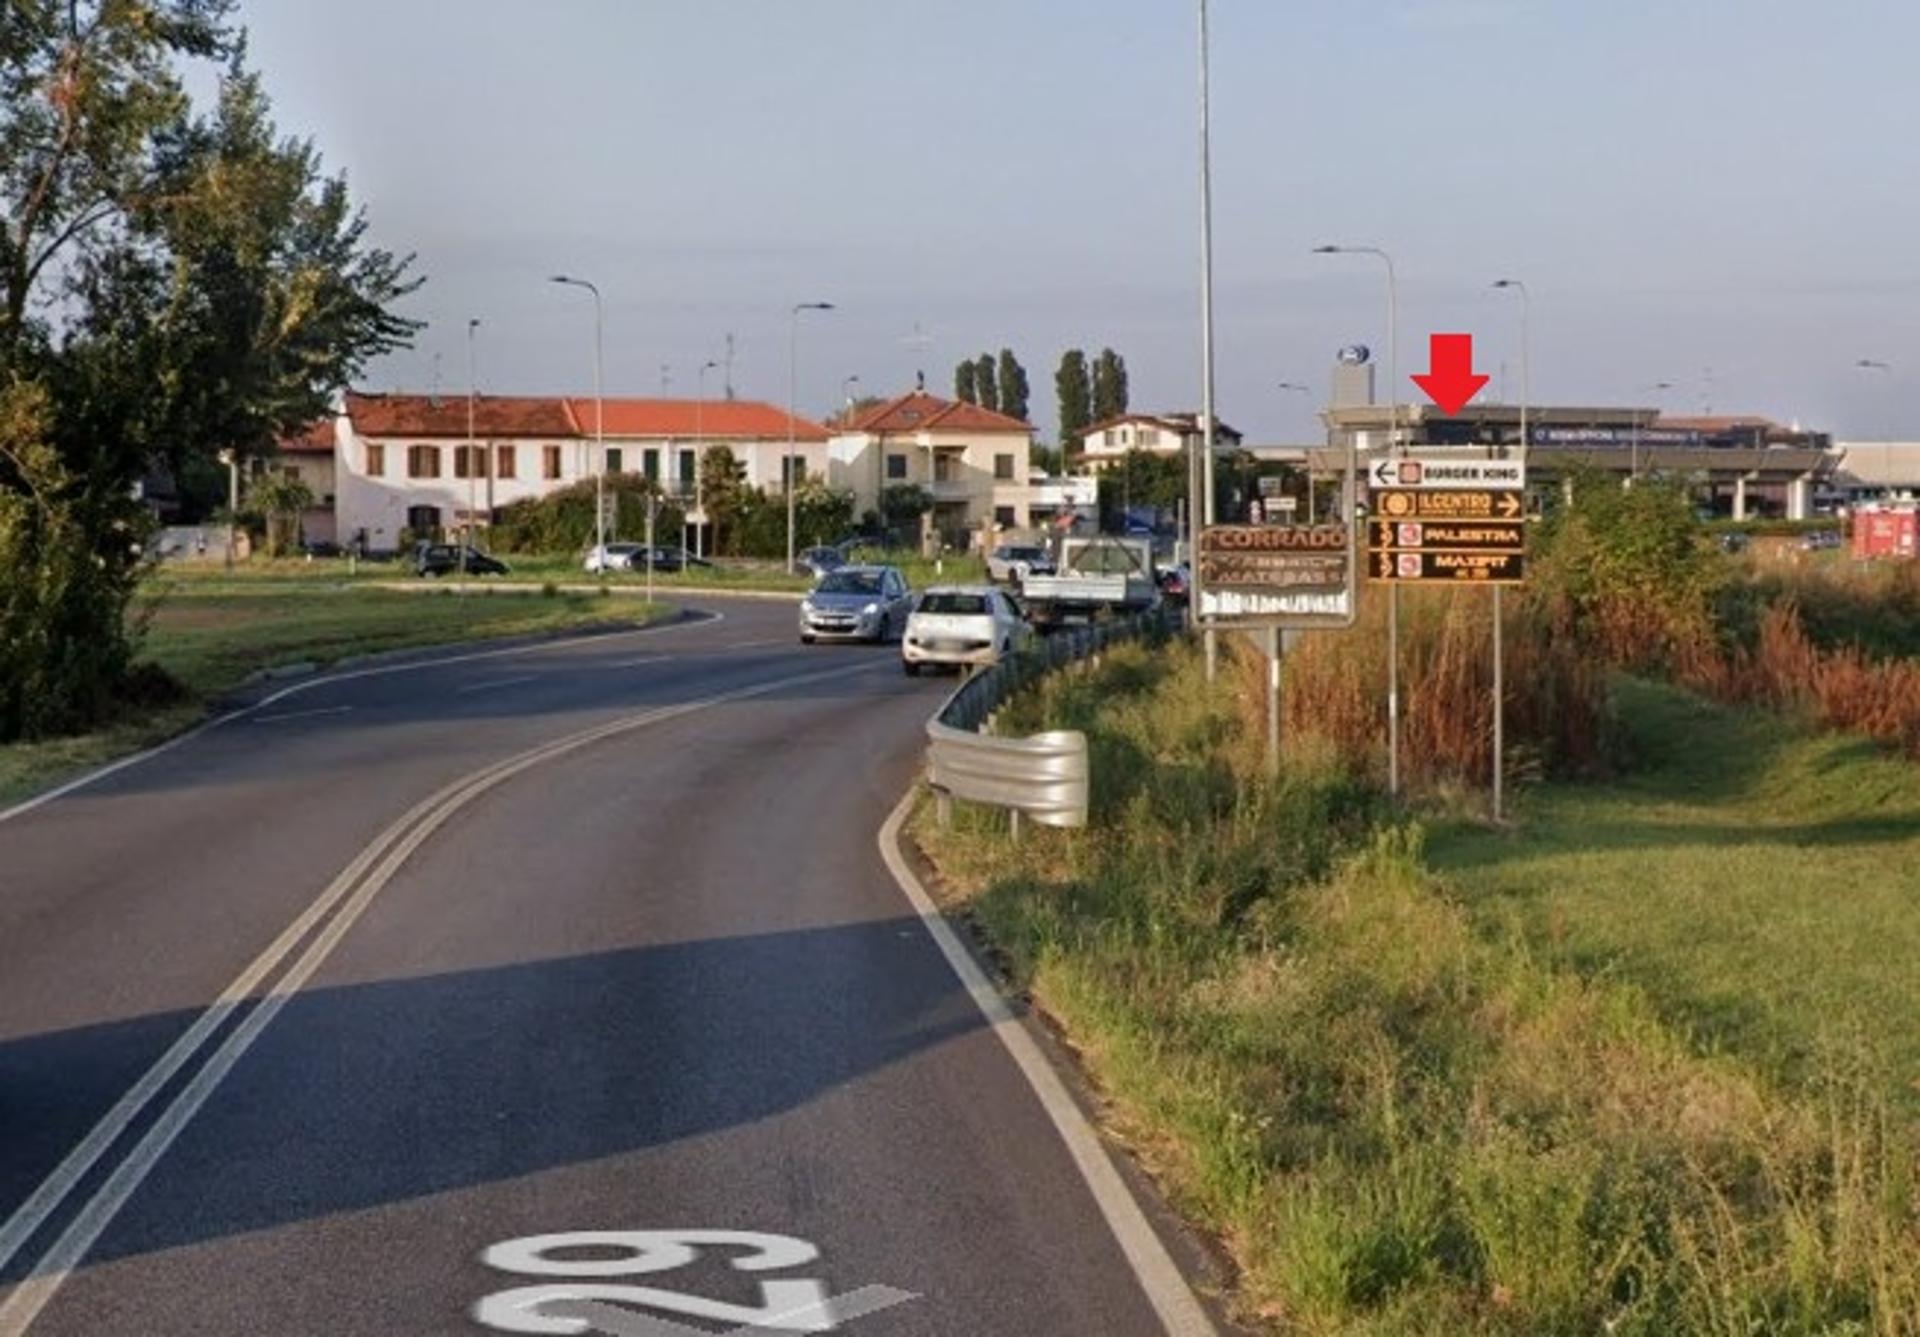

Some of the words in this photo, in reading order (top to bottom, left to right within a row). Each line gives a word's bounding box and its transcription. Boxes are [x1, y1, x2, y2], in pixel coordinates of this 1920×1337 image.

[1424, 467, 1480, 479] BURGER
[1483, 468, 1519, 479] KING
[1219, 531, 1345, 547] CORRADO
[1425, 529, 1519, 542] PALESTRA
